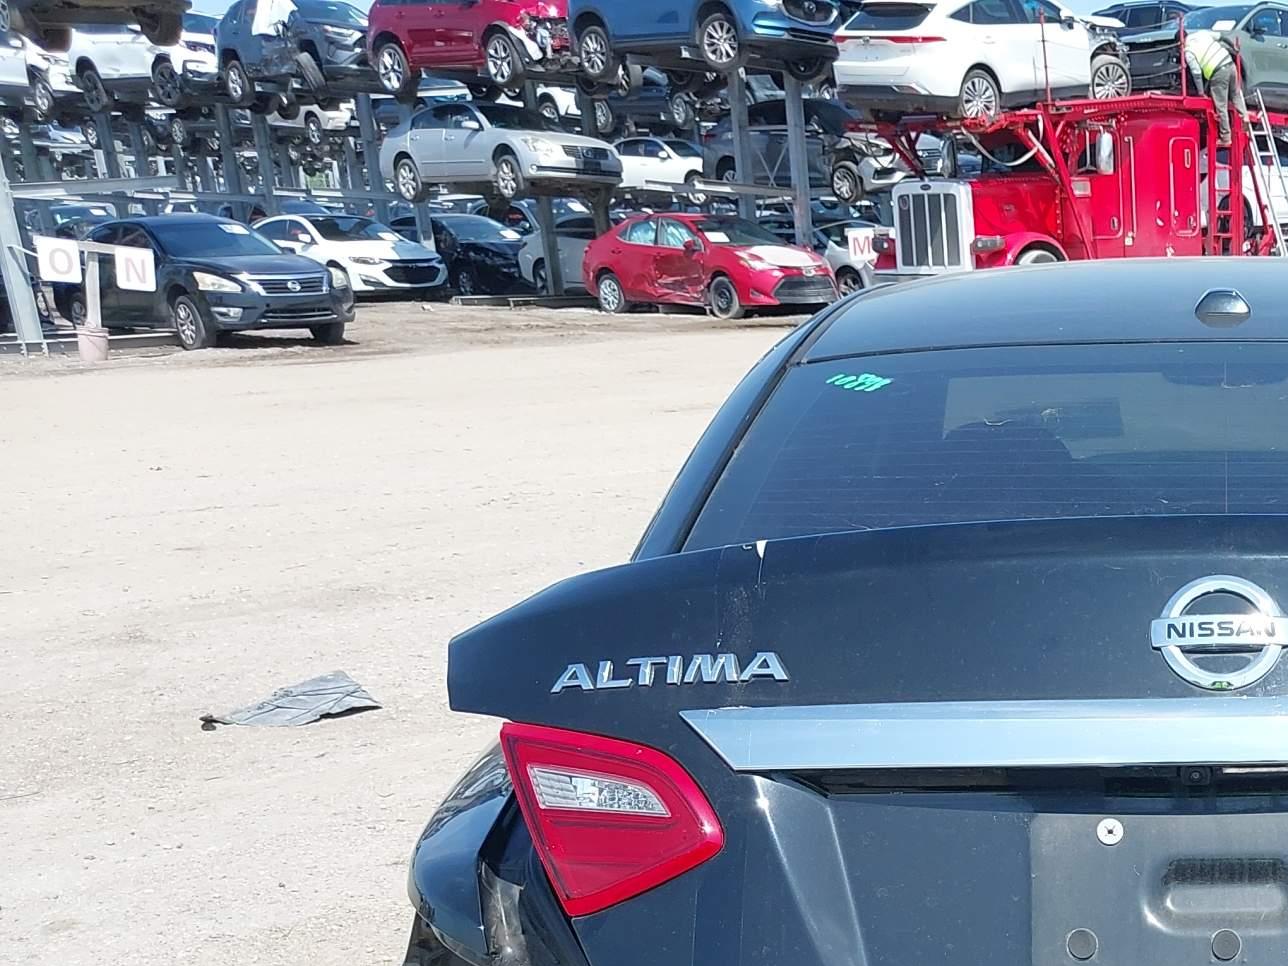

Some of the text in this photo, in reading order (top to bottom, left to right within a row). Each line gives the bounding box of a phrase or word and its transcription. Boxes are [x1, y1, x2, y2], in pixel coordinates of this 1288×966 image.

[852, 235, 871, 256] M
[124, 256, 147, 285] N
[1166, 620, 1276, 640] NISSAN
[550, 652, 790, 693] ALTIMA
